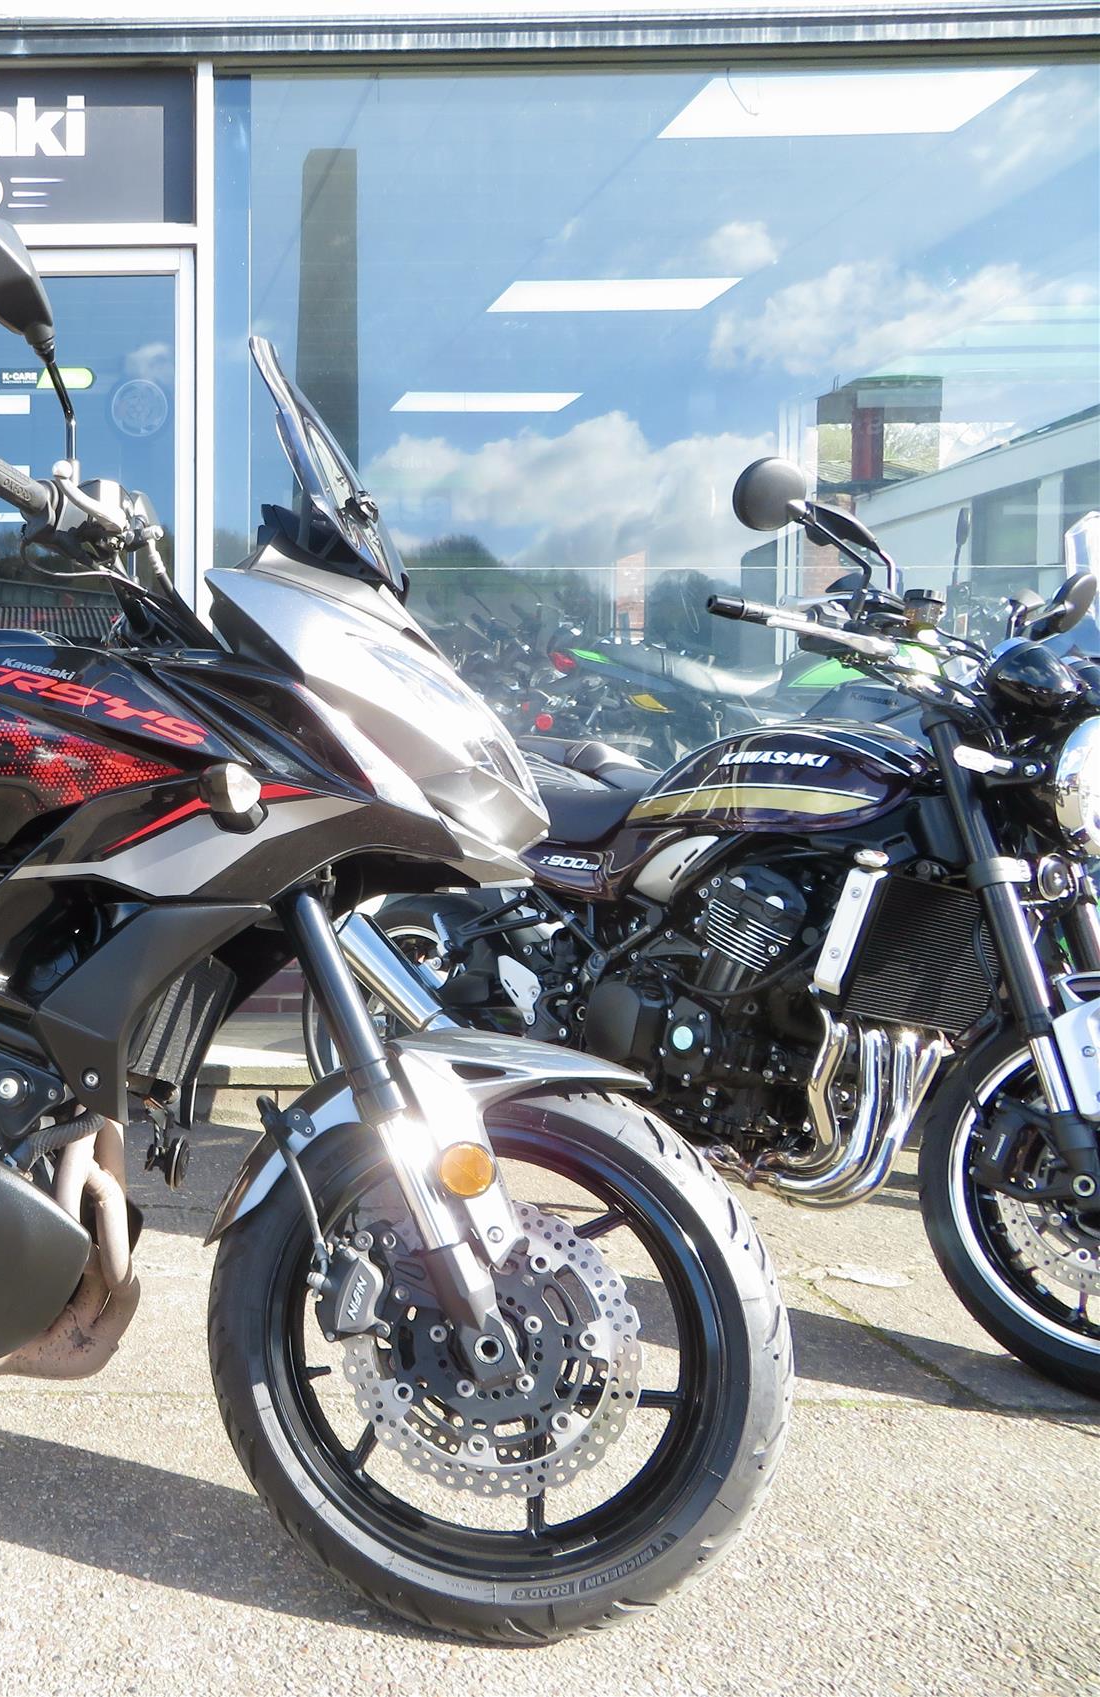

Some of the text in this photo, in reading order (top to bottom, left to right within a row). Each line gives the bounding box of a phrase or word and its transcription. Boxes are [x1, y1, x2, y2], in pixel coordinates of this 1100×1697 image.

[3, 478, 31, 501] OXFORD
[1, 657, 76, 681] Kawasaki
[718, 750, 832, 768] KAWASAKI
[516, 1544, 657, 1599] MICHELIN ROAD 6
